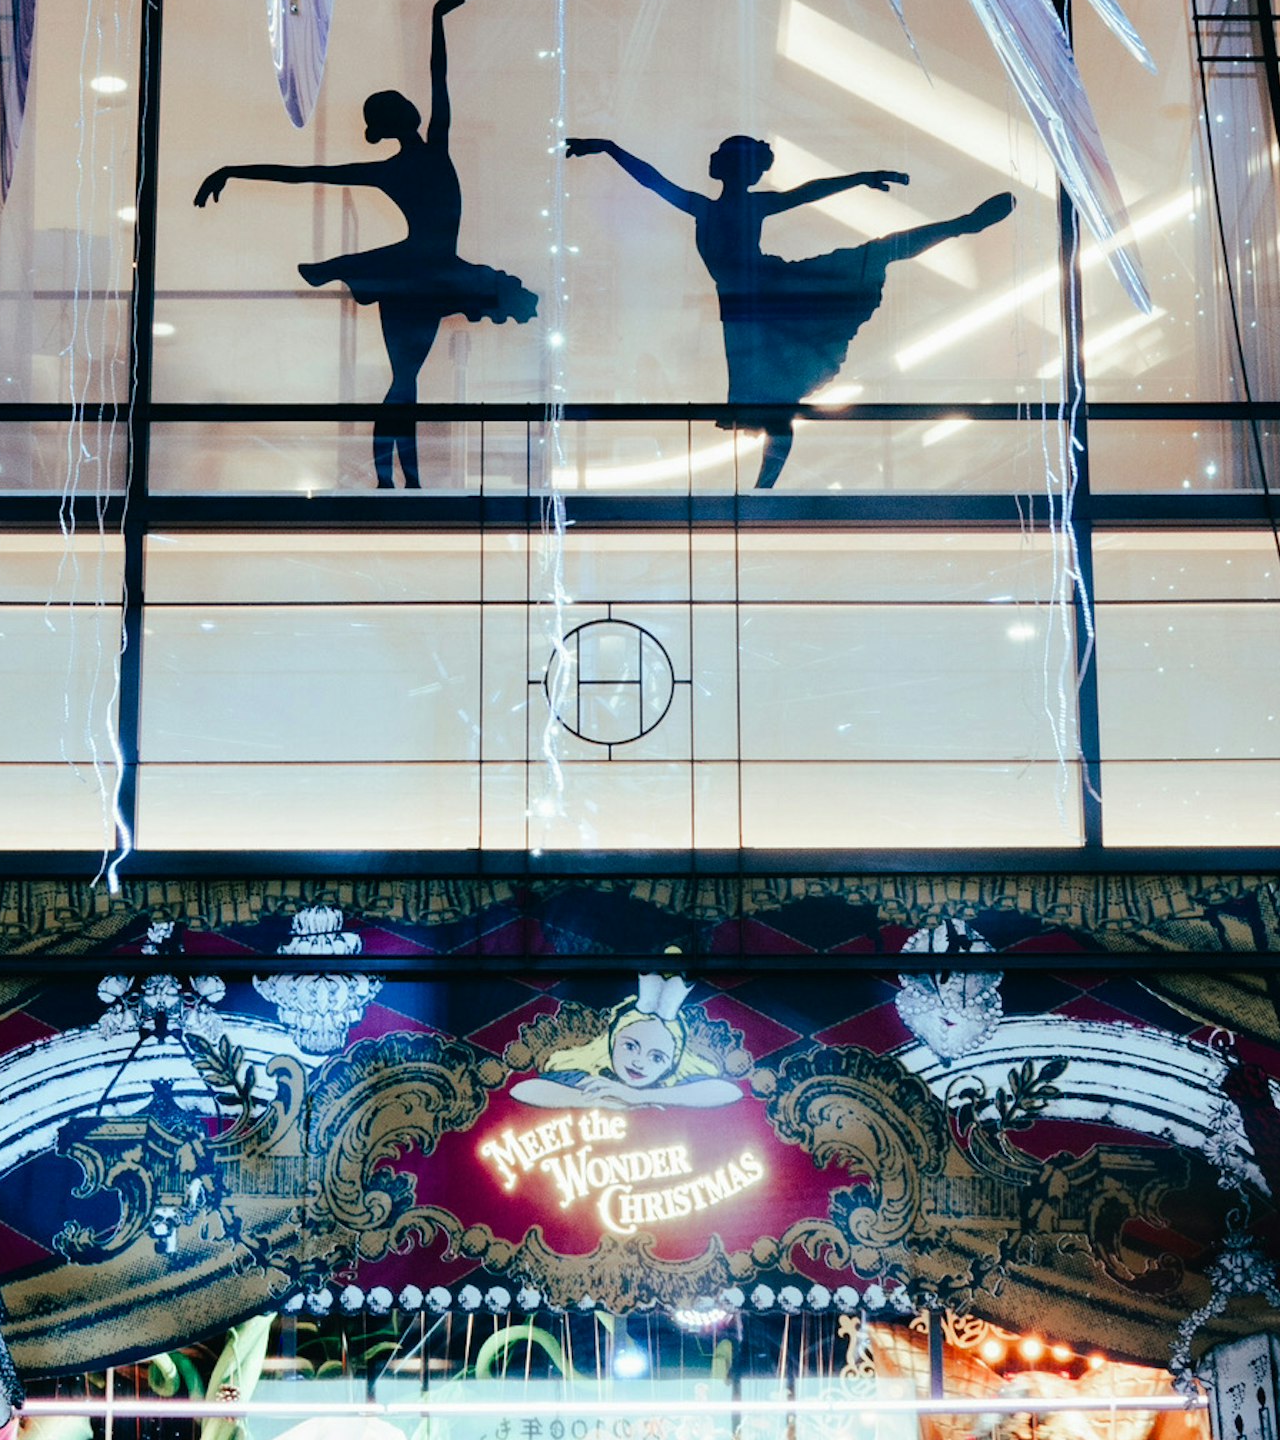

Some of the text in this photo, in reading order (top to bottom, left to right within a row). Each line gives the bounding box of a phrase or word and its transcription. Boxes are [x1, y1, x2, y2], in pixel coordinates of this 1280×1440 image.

[481, 1109, 627, 1190] MEET the
[541, 1143, 693, 1209] WONDER
[597, 1151, 765, 1235] CHRISTMAS
